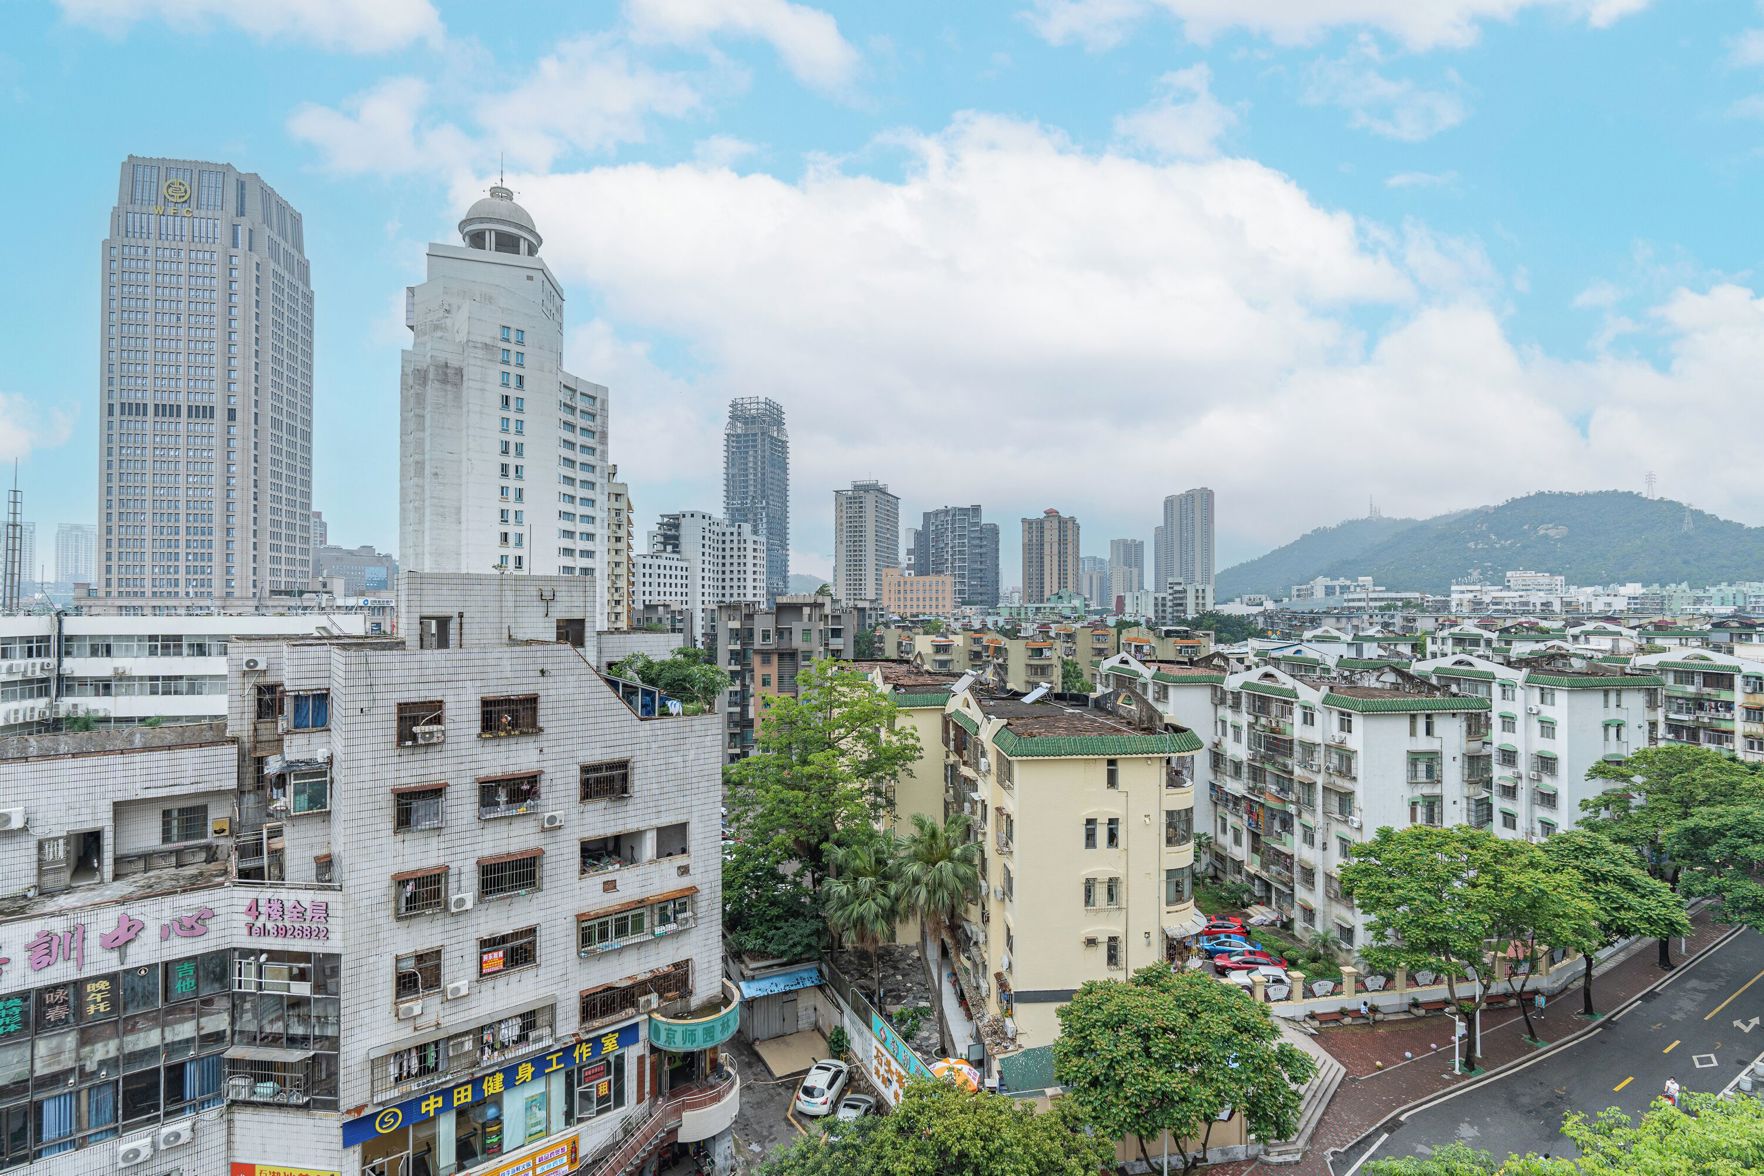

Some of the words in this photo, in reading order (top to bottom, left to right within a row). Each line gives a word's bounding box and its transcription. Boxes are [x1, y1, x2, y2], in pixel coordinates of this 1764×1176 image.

[244, 898, 329, 923] 4楼全层
[176, 962, 197, 993] 吉他
[46, 989, 69, 1022] 咏春
[86, 980, 111, 1015] 晚午托
[421, 1031, 620, 1118] 中田健身工作室
